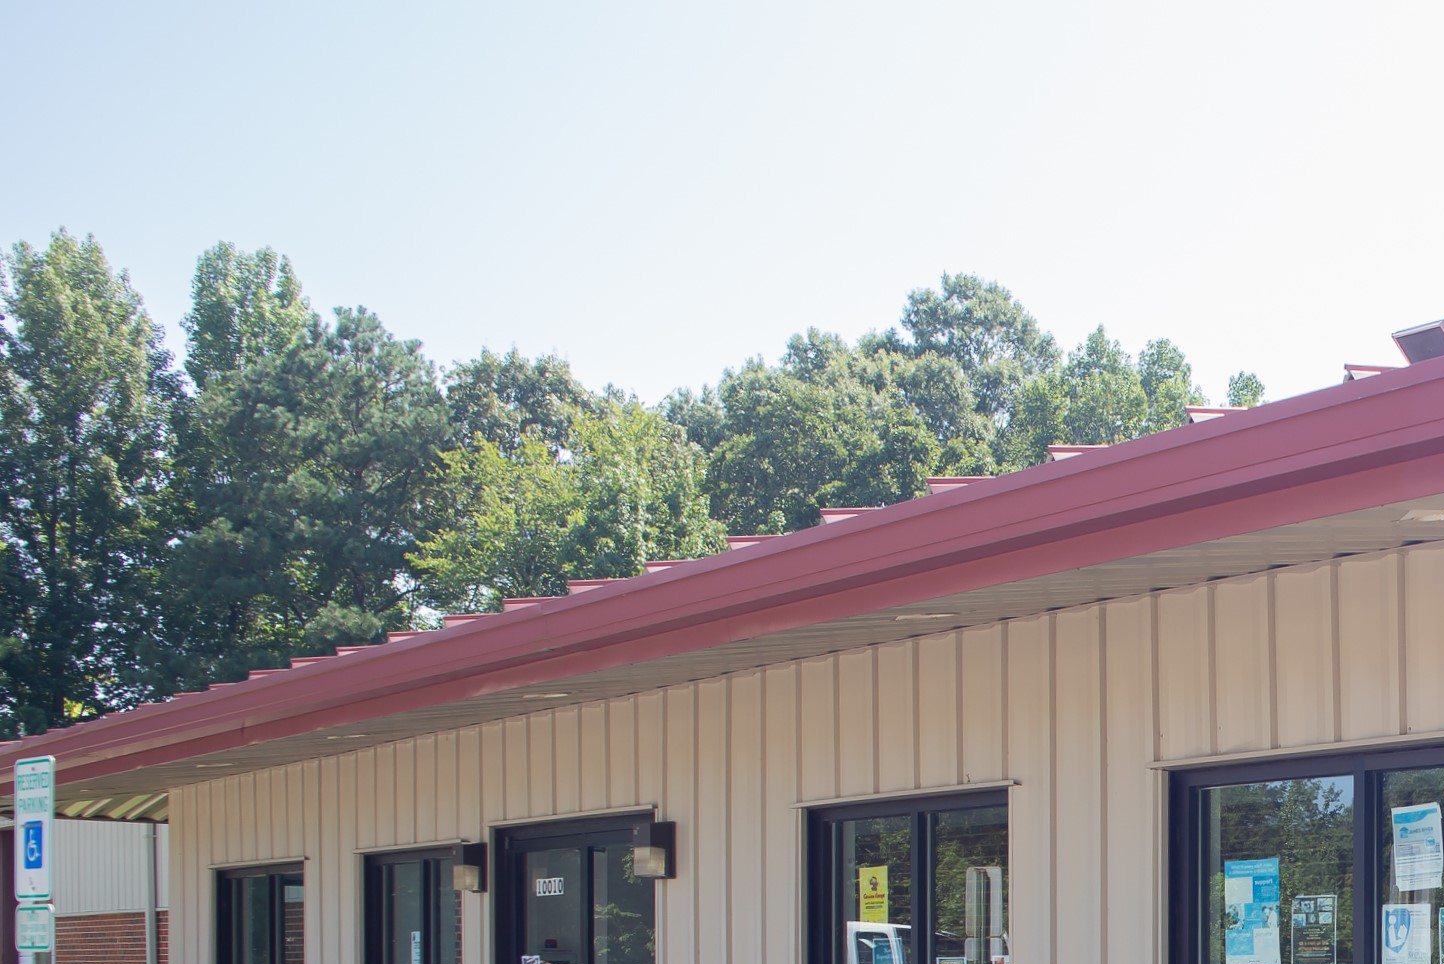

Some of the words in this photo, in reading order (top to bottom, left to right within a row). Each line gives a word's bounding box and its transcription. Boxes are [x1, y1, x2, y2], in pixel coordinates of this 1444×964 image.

[17, 771, 49, 791] RESERVED
[19, 796, 48, 814] PARKING
[537, 879, 564, 895] 10010
